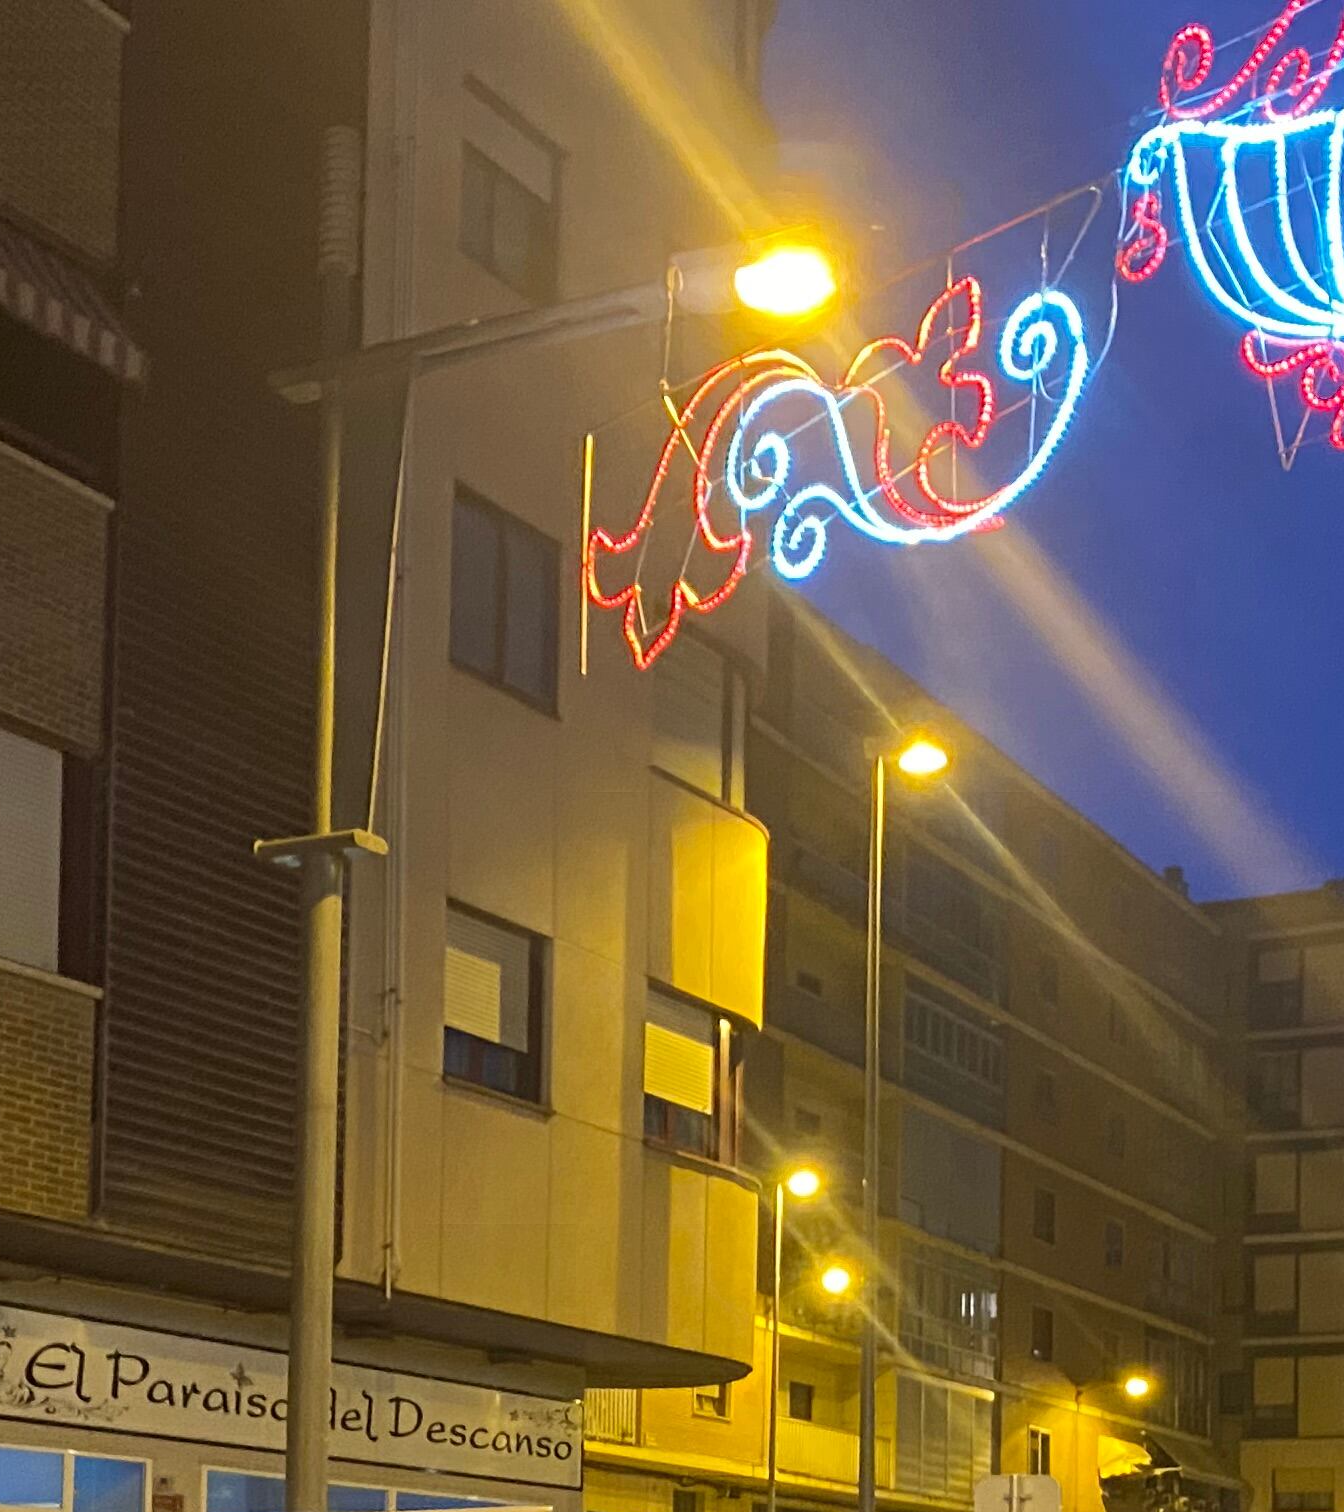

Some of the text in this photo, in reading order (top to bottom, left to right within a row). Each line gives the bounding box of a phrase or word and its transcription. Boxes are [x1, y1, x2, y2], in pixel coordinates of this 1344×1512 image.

[24, 1342, 91, 1403] El
[107, 1348, 288, 1422] Paraiso
[388, 1395, 572, 1461] Descanso
